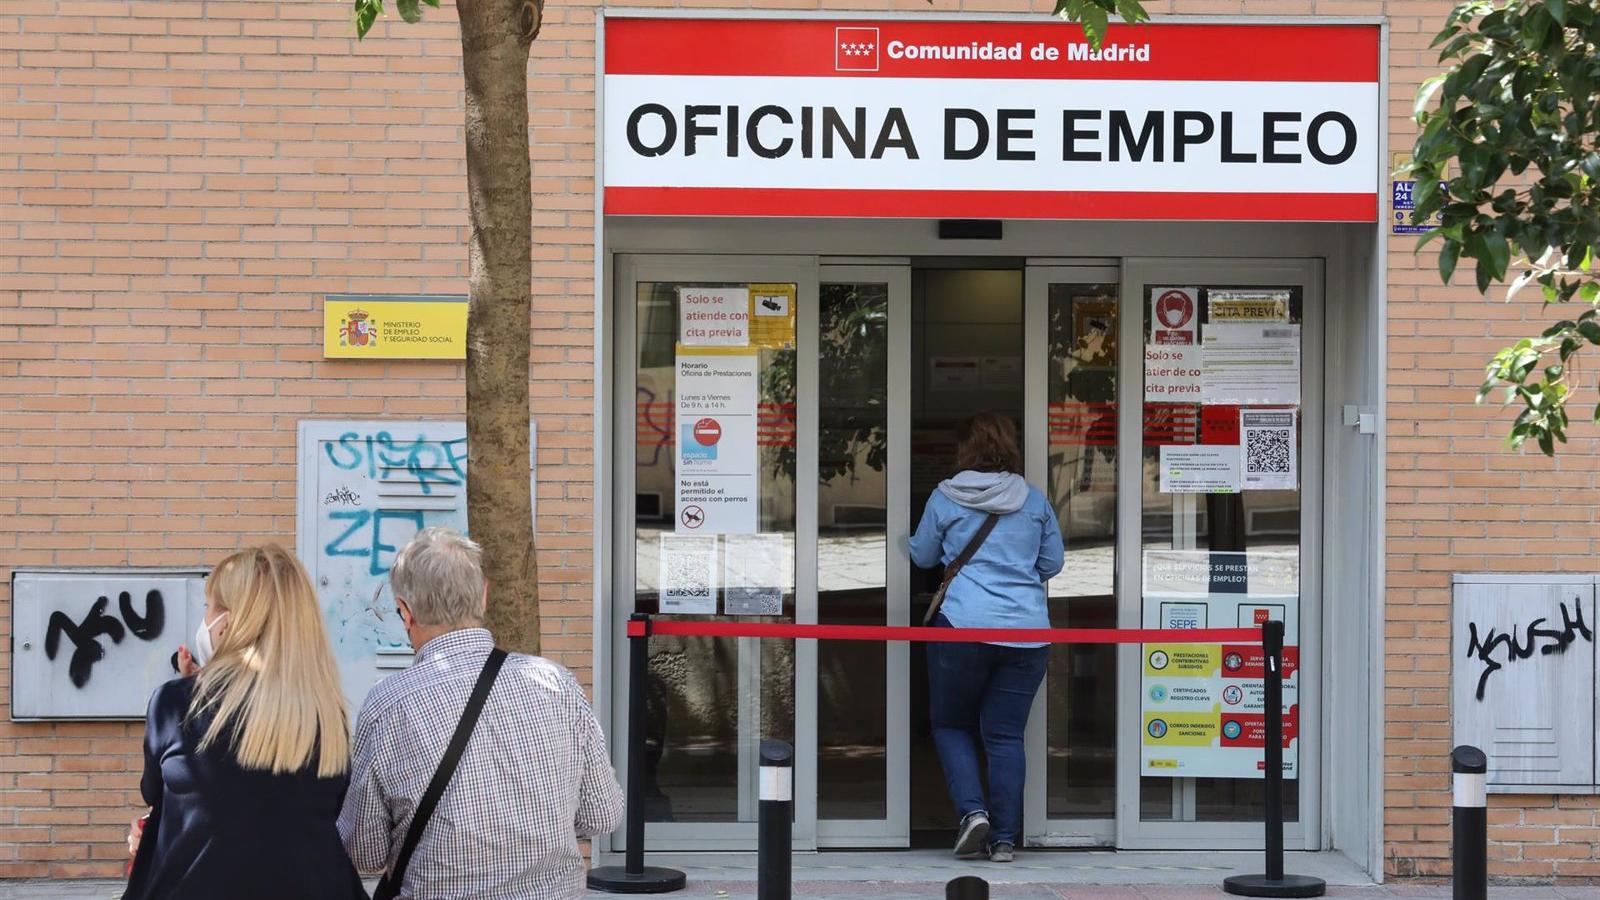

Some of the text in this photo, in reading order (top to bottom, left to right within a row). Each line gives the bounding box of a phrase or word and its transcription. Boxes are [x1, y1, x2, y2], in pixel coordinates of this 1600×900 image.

[887, 40, 1150, 62] Comunidad de Madrid
[625, 103, 1358, 165] OFICINA DE EMPLEO
[1395, 192, 1408, 200] 24
[685, 294, 724, 304] Solo se
[685, 310, 748, 321] atiende con
[1215, 307, 1241, 317] CITA
[686, 328, 706, 337] cita
[708, 328, 742, 339] previa
[1146, 350, 1183, 360] Solo se
[1146, 367, 1201, 377] atiende co
[1146, 383, 1201, 395] cita previa
[1215, 564, 1224, 572] SE
[1225, 564, 1258, 572] PRESTAN
[1213, 575, 1247, 583] EMPLEO?
[1169, 619, 1198, 629] SEPE
